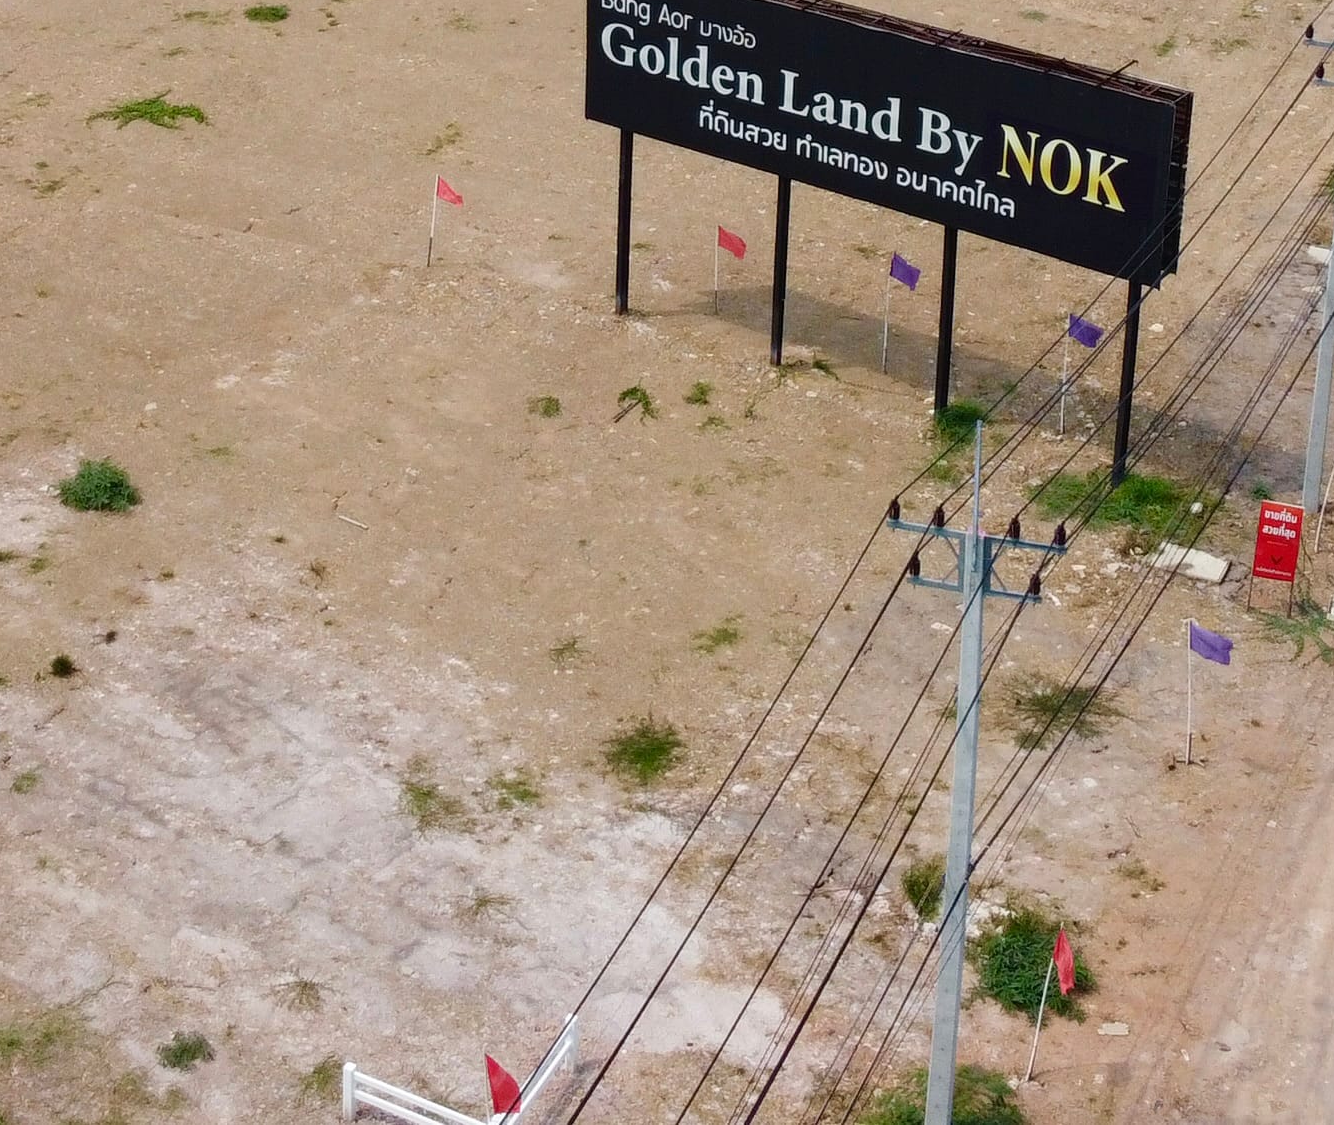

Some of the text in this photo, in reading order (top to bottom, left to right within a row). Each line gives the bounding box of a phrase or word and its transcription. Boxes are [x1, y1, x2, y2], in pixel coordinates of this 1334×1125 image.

[658, 3, 694, 31] Aor
[700, 19, 756, 49] บางอ้อ
[601, 22, 1128, 213] Golden Land By NOK
[699, 100, 1015, 218] ที่ดินสวย ทำเลทอง อนาคตไกล
